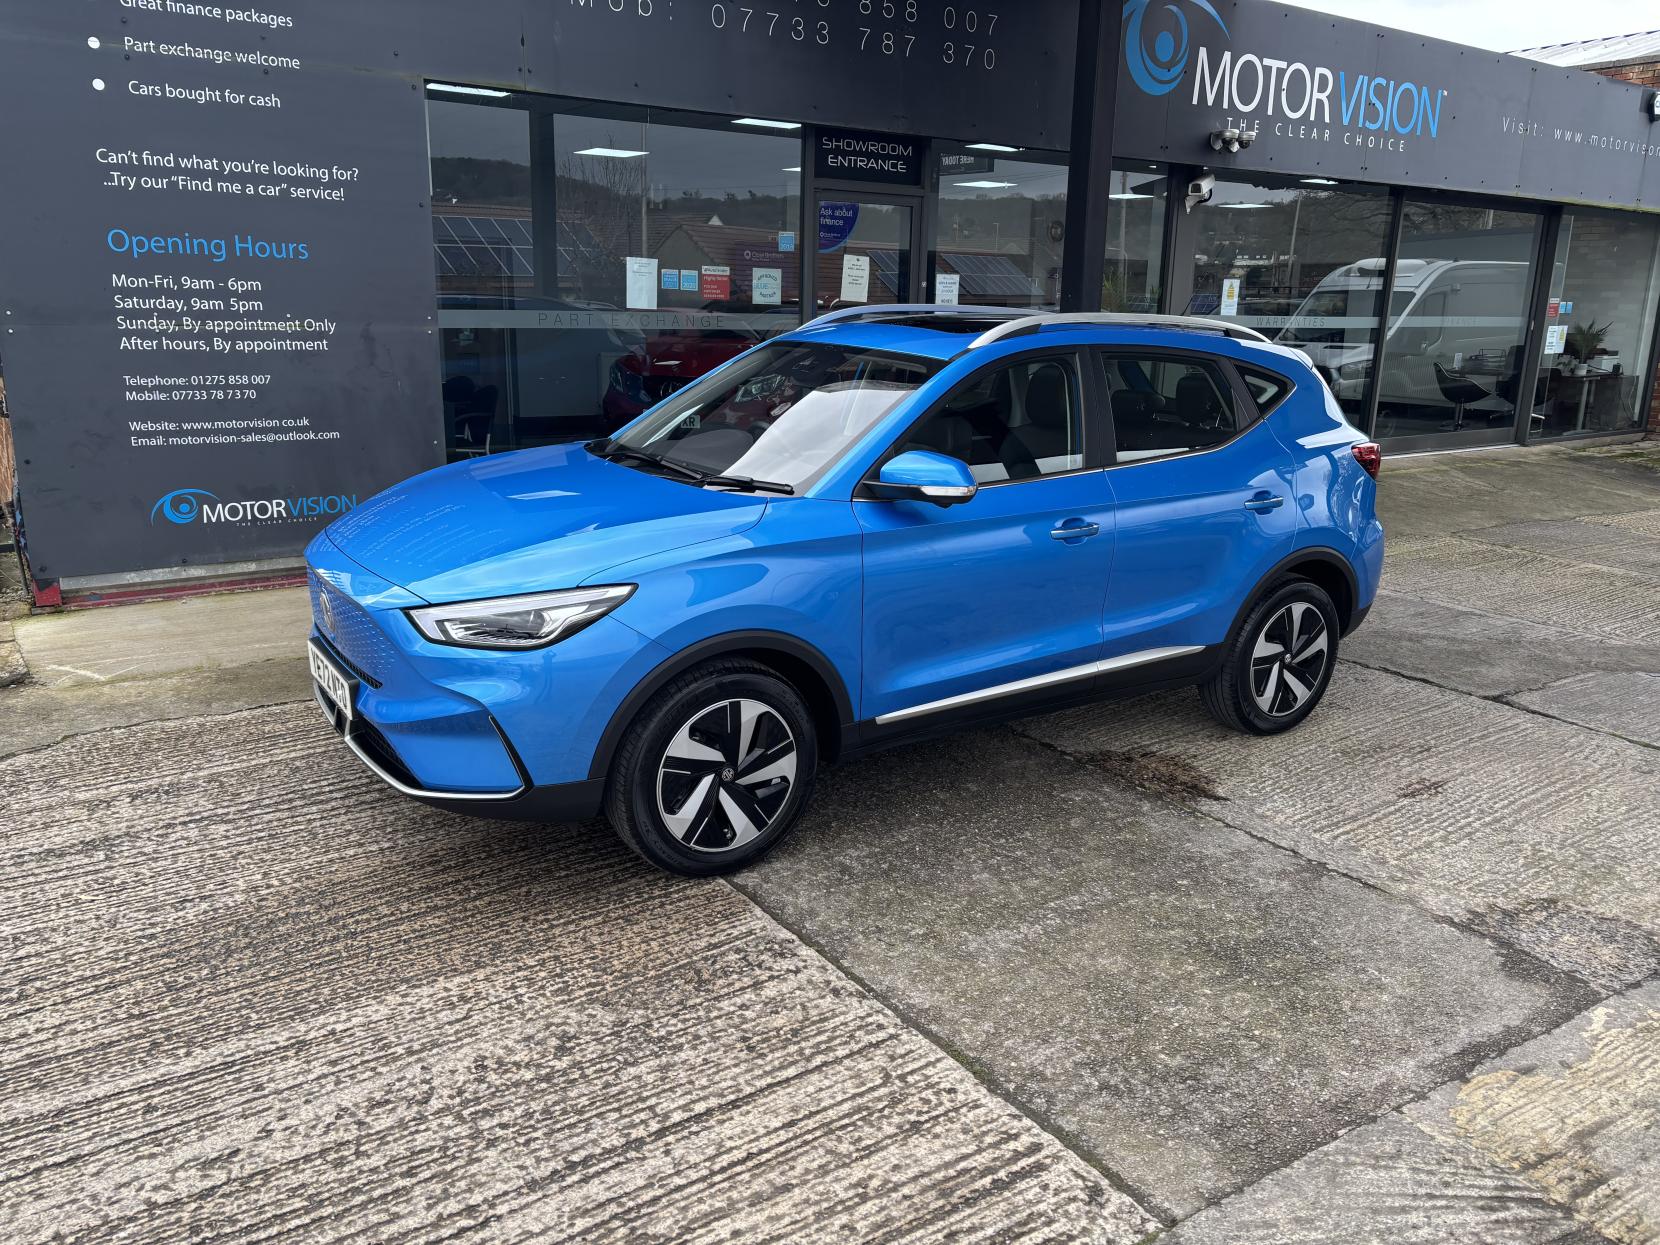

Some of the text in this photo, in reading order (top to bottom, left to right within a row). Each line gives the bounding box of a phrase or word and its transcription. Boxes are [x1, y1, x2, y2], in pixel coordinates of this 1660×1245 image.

[166, 0, 222, 18] finance
[225, 9, 293, 28] packages
[944, 7, 998, 36] 007
[570, 0, 996, 70] ob: 07733 787 370
[124, 36, 300, 69] Part exchange welcome
[128, 80, 281, 108] Cars bought for cash
[1227, 117, 1407, 152] THE CLEAR CHOICE
[1502, 116, 1545, 137] Visit:
[822, 136, 913, 157] SHOWROOM
[96, 148, 359, 182] Can't find what you're looking for?
[827, 154, 907, 173] ENTRANCE
[141, 177, 169, 189] our
[217, 182, 242, 194] me
[245, 184, 254, 195] a
[290, 186, 345, 202] service!
[820, 206, 853, 217] Ask about
[107, 228, 309, 263] Opening Hours
[112, 273, 178, 291] Mon-Fri,
[181, 275, 215, 290] 9am
[227, 277, 262, 294] 6pm
[114, 294, 263, 314] Saturday, 9am 5pm
[116, 314, 337, 335] Sunday, By appointment Only
[538, 311, 726, 328] PART EXCHANGE
[120, 336, 329, 354] After hours, By appointment
[122, 374, 271, 388] Telephone: 01275 858 007
[125, 390, 170, 401] Mobile:
[171, 389, 207, 401] 07733
[128, 420, 180, 431] Website:
[131, 430, 340, 447] Email: motorvision-sales@outlook.com
